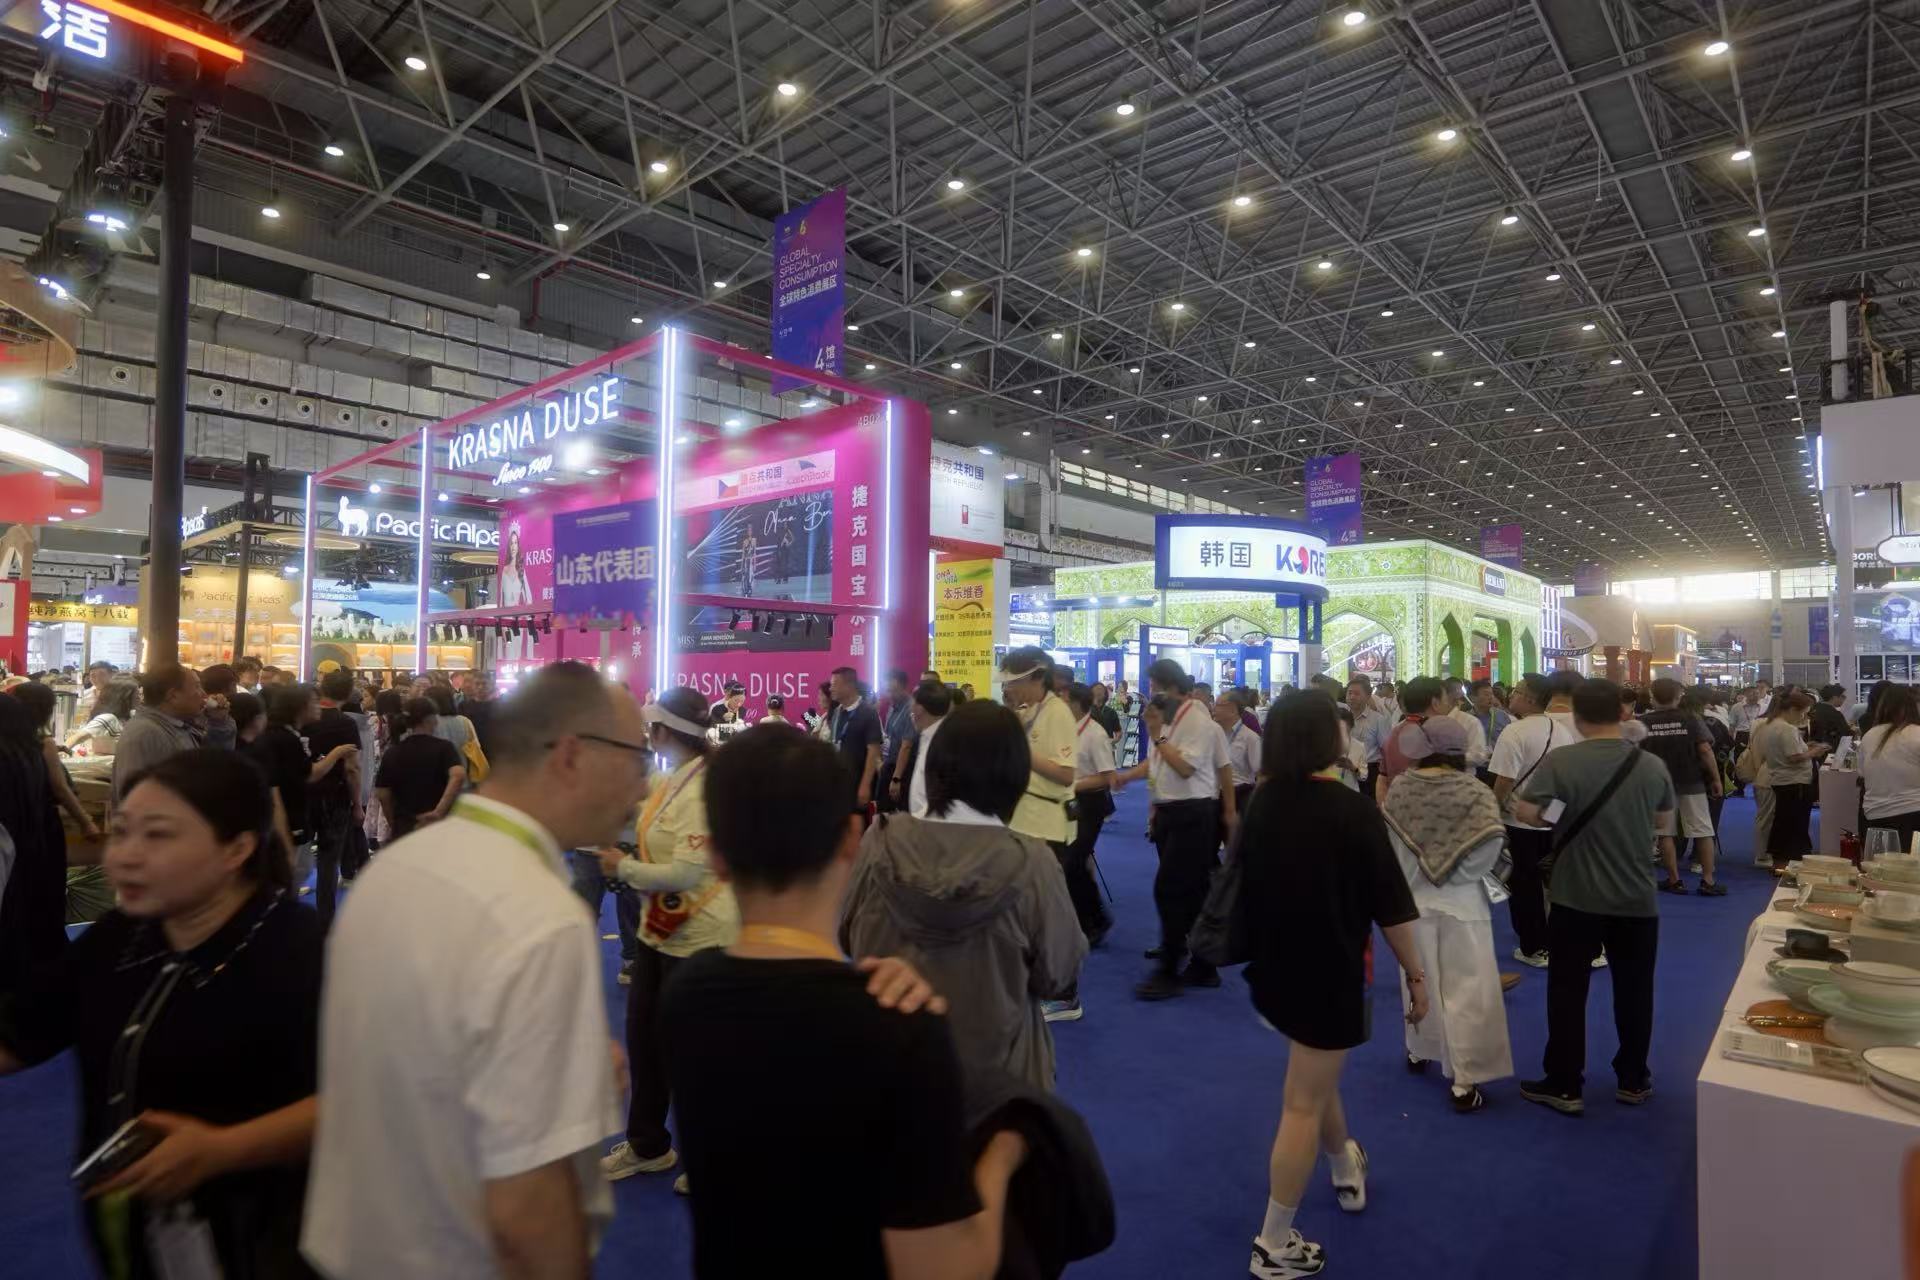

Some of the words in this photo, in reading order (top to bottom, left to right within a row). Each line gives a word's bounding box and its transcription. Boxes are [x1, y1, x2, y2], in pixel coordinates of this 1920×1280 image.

[40, 0, 110, 58] 活
[780, 246, 811, 266] GLOBAL
[780, 254, 821, 278] SPECIALTY
[780, 259, 838, 290] CONSUMPTION
[815, 348, 825, 370] 4
[449, 411, 534, 470] KRASNA
[544, 378, 618, 440] DUSE
[493, 462, 526, 486] Since
[527, 454, 553, 476] 1900
[1310, 479, 1334, 487] GLOBAL
[376, 512, 450, 541] Pacic
[556, 546, 656, 586] 山东代表团
[1200, 541, 1252, 568] 韩国
[750, 672, 810, 699] DUSE
